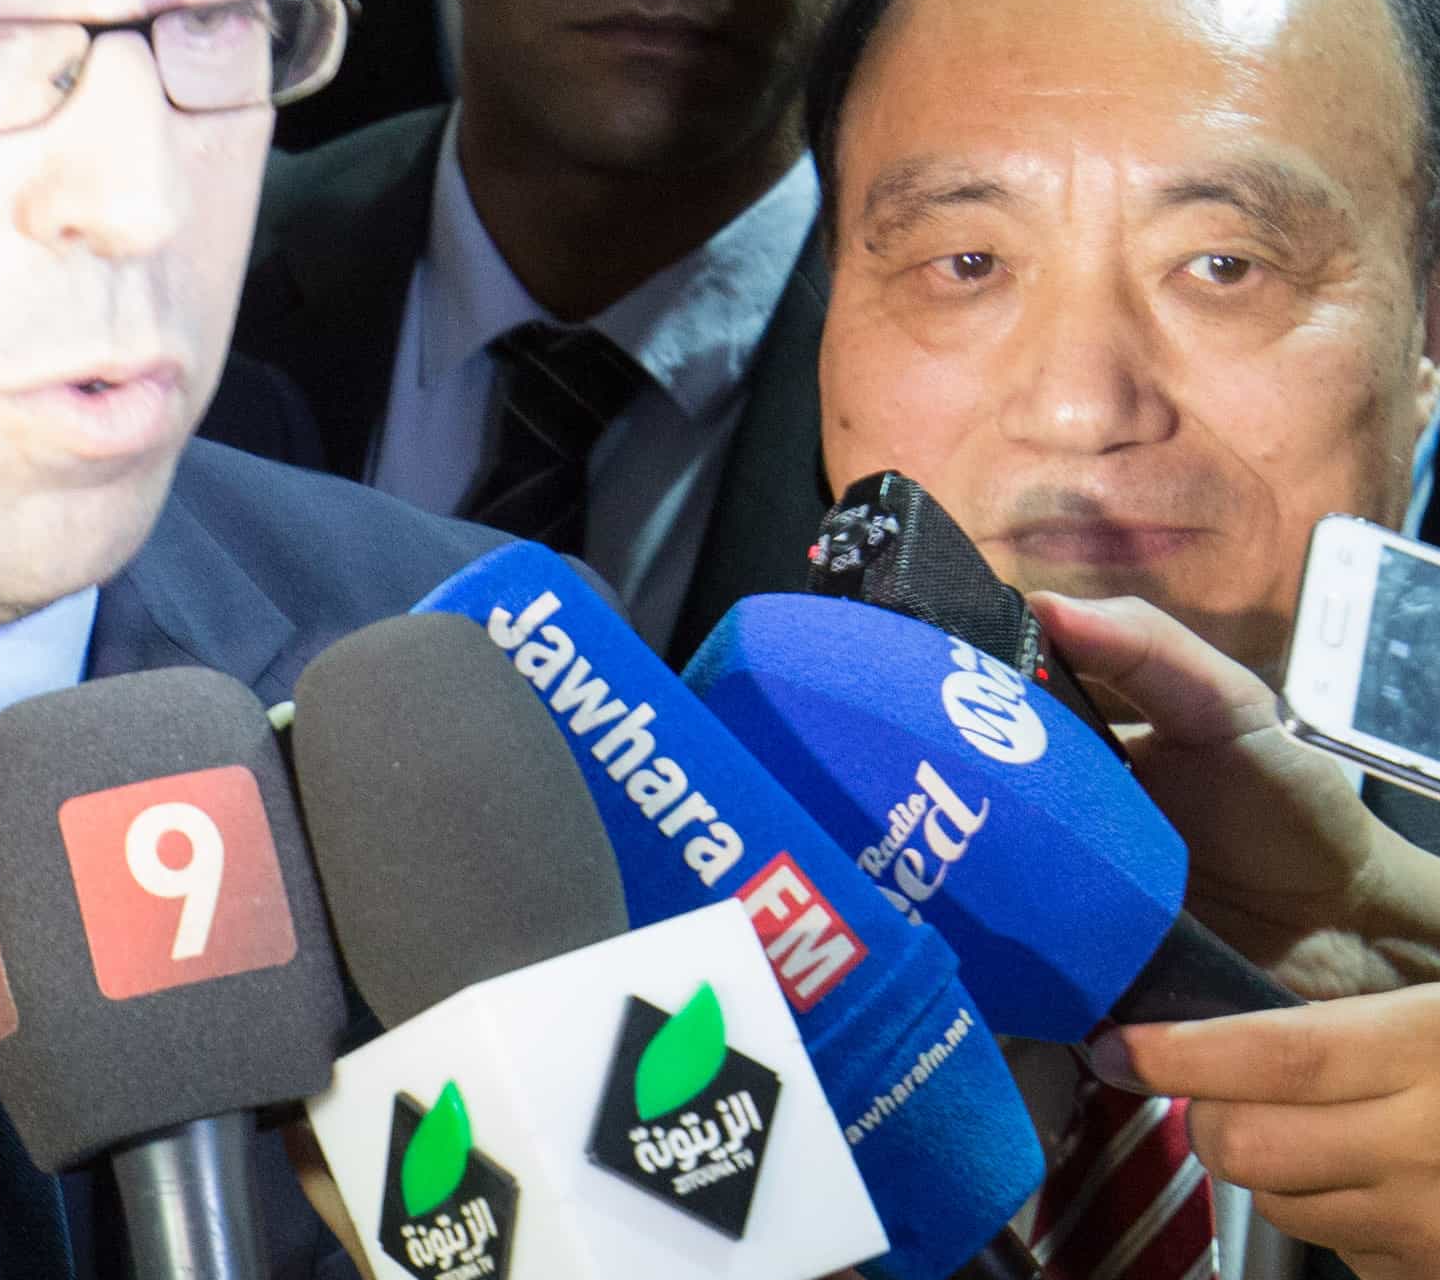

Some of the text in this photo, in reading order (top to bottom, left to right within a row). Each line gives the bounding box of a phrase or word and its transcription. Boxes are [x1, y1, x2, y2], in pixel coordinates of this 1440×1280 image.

[487, 590, 744, 888] Jawhara
[125, 802, 225, 961] 9
[857, 793, 928, 878] Radio
[742, 864, 857, 1000] FM
[629, 1090, 763, 1173] الزيتونة
[844, 1007, 975, 1145] awharafm.net
[400, 1196, 499, 1272] الزيتونة
